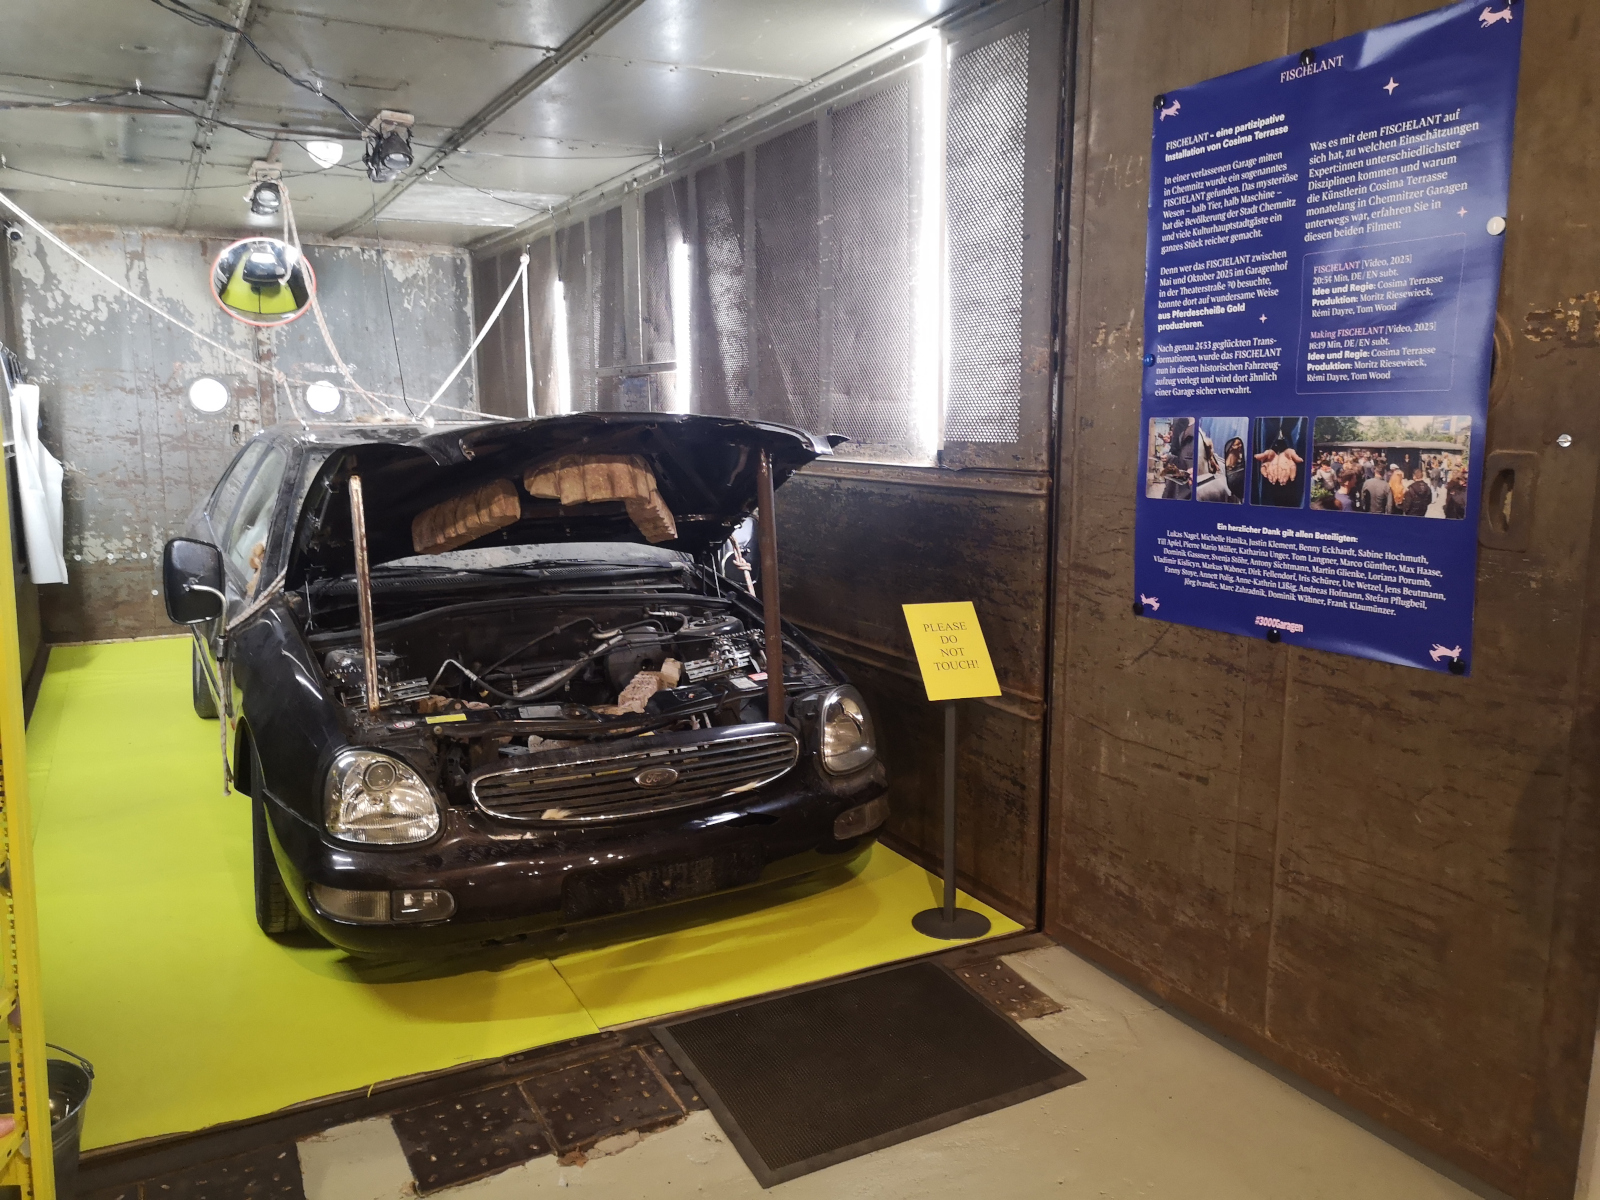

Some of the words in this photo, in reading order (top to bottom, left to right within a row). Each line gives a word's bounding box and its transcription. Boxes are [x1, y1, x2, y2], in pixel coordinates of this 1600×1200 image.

[1216, 127, 1233, 138] eine
[1235, 113, 1285, 135] partizipative
[1309, 141, 1327, 152] Was
[1327, 138, 1339, 148] es
[1339, 133, 1356, 146] mit
[1357, 129, 1378, 142] dem
[1443, 108, 1461, 123] auf
[1165, 146, 1205, 162] Installation
[1207, 143, 1221, 152] von
[1222, 134, 1253, 148] Cosima
[1254, 125, 1289, 140] Terrasse
[1309, 152, 1327, 166] sich
[1328, 150, 1345, 161] hat,
[1345, 148, 1357, 158] zu
[1357, 138, 1397, 155] welchen
[1399, 121, 1479, 147] Einschätzungen
[1164, 177, 1172, 185] In
[1172, 174, 1190, 183] einer
[1190, 164, 1231, 179] verlassenen
[1232, 158, 1257, 170] Garage
[1258, 151, 1283, 164] mitten
[1308, 159, 1364, 179] Expert:innen
[1365, 139, 1462, 167] unterschiedlichster
[1164, 188, 1171, 196] in
[1172, 182, 1204, 195] Chemnitz
[1205, 175, 1227, 187] wurde
[1228, 174, 1240, 183] ein
[1241, 163, 1288, 181] sogenanntes
[1308, 173, 1356, 191] Disziplinen
[1357, 166, 1399, 182] kommen
[1400, 160, 1420, 174] und
[1421, 154, 1457, 169] warum
[1206, 186, 1241, 201] gefunden.
[1242, 181, 1255, 192] Das
[1256, 173, 1299, 190] mysteriöse
[1306, 193, 1321, 204] die
[1321, 185, 1368, 201] Künstlerin
[1369, 179, 1404, 193] Cosima
[1406, 170, 1449, 186] Terrasse
[1163, 208, 1185, 219] Wesen
[1192, 203, 1207, 214] halb
[1208, 201, 1223, 210] Tier,
[1224, 196, 1239, 207] halb
[1241, 191, 1275, 205] Maschine
[1305, 200, 1357, 217] monatelang
[1357, 197, 1367, 208] in
[1368, 189, 1425, 206] Chemnitzer
[1426, 181, 1468, 196] Garagen
[1162, 222, 1173, 230] hat
[1173, 219, 1184, 228] die
[1185, 210, 1226, 227] Bevölkerung
[1227, 209, 1239, 219] der
[1240, 205, 1258, 216] Stadt
[1259, 198, 1297, 212] Chemnitz
[1305, 214, 1350, 230] unterwegs
[1350, 212, 1370, 223] war,
[1371, 206, 1412, 220] erfahren
[1413, 201, 1429, 213] Sie
[1431, 199, 1441, 210] in
[1162, 233, 1175, 242] und
[1176, 229, 1192, 239] viele
[1192, 216, 1269, 237] Kulturhauptstadtgäste
[1269, 213, 1282, 222] ein
[1304, 231, 1333, 243] diesen
[1333, 225, 1365, 238] beiden
[1366, 220, 1402, 234] Filmen:
[1160, 242, 1183, 255] ganzes
[1184, 238, 1203, 249] Stück
[1204, 234, 1229, 246] reicher
[1230, 229, 1263, 244] gemacht.
[1159, 277, 1172, 287] Mai
[1173, 274, 1186, 285] und
[1187, 272, 1215, 283] Oktober
[1216, 269, 1234, 279] 2025
[1234, 268, 1245, 277] im
[1245, 260, 1288, 276] Garagenhof
[1160, 265, 1179, 276] Denn
[1179, 264, 1193, 273] wer
[1193, 262, 1205, 271] das
[1251, 250, 1287, 263] zwischen
[1159, 289, 1166, 298] in
[1167, 286, 1179, 297] der
[1180, 281, 1226, 295] Theaterstraße
[1237, 276, 1272, 289] besuchte,
[1312, 286, 1331, 296] Idee
[1331, 284, 1348, 294] und
[1350, 282, 1377, 293] Regie:
[1377, 279, 1407, 289] Cosima
[1409, 275, 1444, 286] Terrasse
[1158, 298, 1182, 309] konnte
[1182, 297, 1198, 307] dort
[1198, 295, 1211, 305] auf
[1211, 290, 1256, 303] wundersame
[1256, 287, 1279, 298] Weise
[1312, 295, 1359, 307] Produktion:
[1360, 292, 1385, 302] Moritz
[1356, 304, 1374, 314] Tom
[1374, 302, 1397, 312] Wood
[1158, 312, 1171, 320] aus
[1172, 305, 1225, 319] Pferdescheiße
[1227, 303, 1246, 313] Gold
[1157, 320, 1204, 333] produzieren.
[1310, 330, 1336, 341] Making
[1307, 351, 1325, 361] Idee
[1326, 349, 1343, 360] und
[1344, 349, 1371, 360] Regie:
[1371, 347, 1400, 357] Cosima
[1401, 346, 1437, 356] Terrasse
[1307, 361, 1353, 372] Produktion:
[1354, 360, 1379, 370] Moritz
[1351, 371, 1368, 381] Tom
[1368, 370, 1391, 380] Wood
[1217, 522, 1227, 531] Ein
[1228, 524, 1261, 535] herzlicher
[1262, 527, 1281, 536] Dank
[1282, 529, 1294, 538] gilt
[1295, 530, 1314, 539] allen
[1314, 531, 1359, 543] Beteiligten:
[1298, 543, 1321, 554] Benny
[1357, 548, 1384, 559] Sabine
[1291, 552, 1307, 562] Tom
[1340, 558, 1363, 568] Marco
[1398, 564, 1416, 574] Max
[1312, 565, 1336, 575] Martin
[1368, 571, 1397, 583] Loriana
[1298, 573, 1310, 582] Iris
[1342, 579, 1355, 589] Ute
[1384, 584, 1402, 594] Jens
[1298, 584, 1328, 595] Andreas
[1365, 593, 1389, 604] Stefan
[1327, 599, 1348, 609] Frank
[1349, 601, 1397, 616] Klaumünzer.
[923, 622, 968, 632] PLEASE
[940, 635, 958, 644] DO
[940, 647, 965, 657] NOT
[933, 659, 980, 671] TOUCH!
